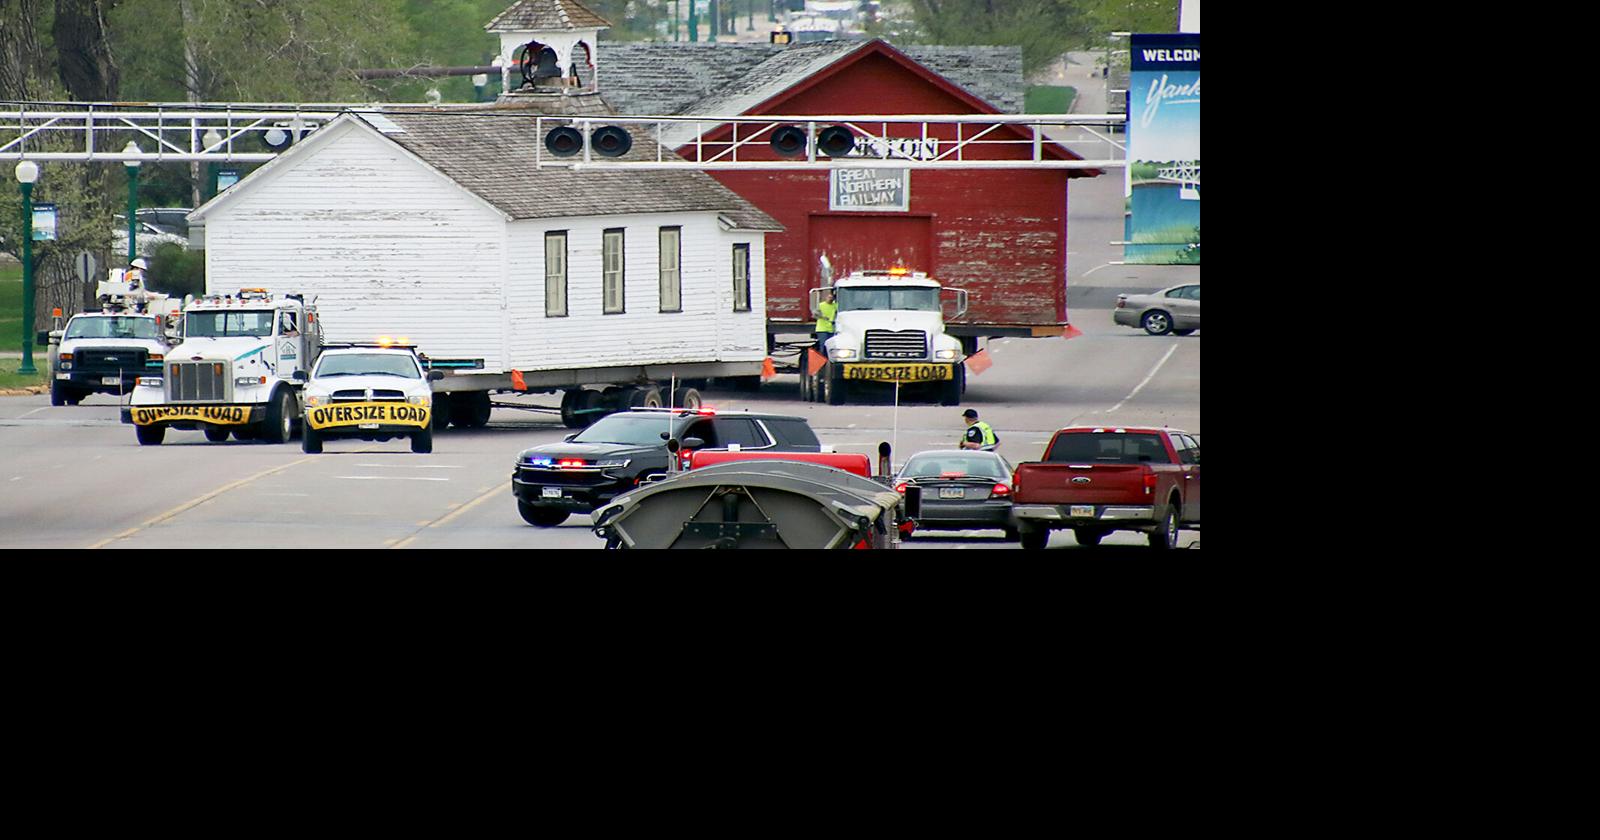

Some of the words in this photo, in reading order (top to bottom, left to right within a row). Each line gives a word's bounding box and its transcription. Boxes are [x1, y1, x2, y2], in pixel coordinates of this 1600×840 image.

[838, 168, 876, 182] GREAT
[839, 178, 902, 194] NORTHERN
[840, 190, 896, 206] RAILWAY
[849, 366, 911, 380] OVERSIZE
[915, 365, 948, 380] LOAD
[203, 407, 243, 422] LOAD
[314, 406, 385, 424] OVERSIZE
[390, 406, 427, 422] LOAD
